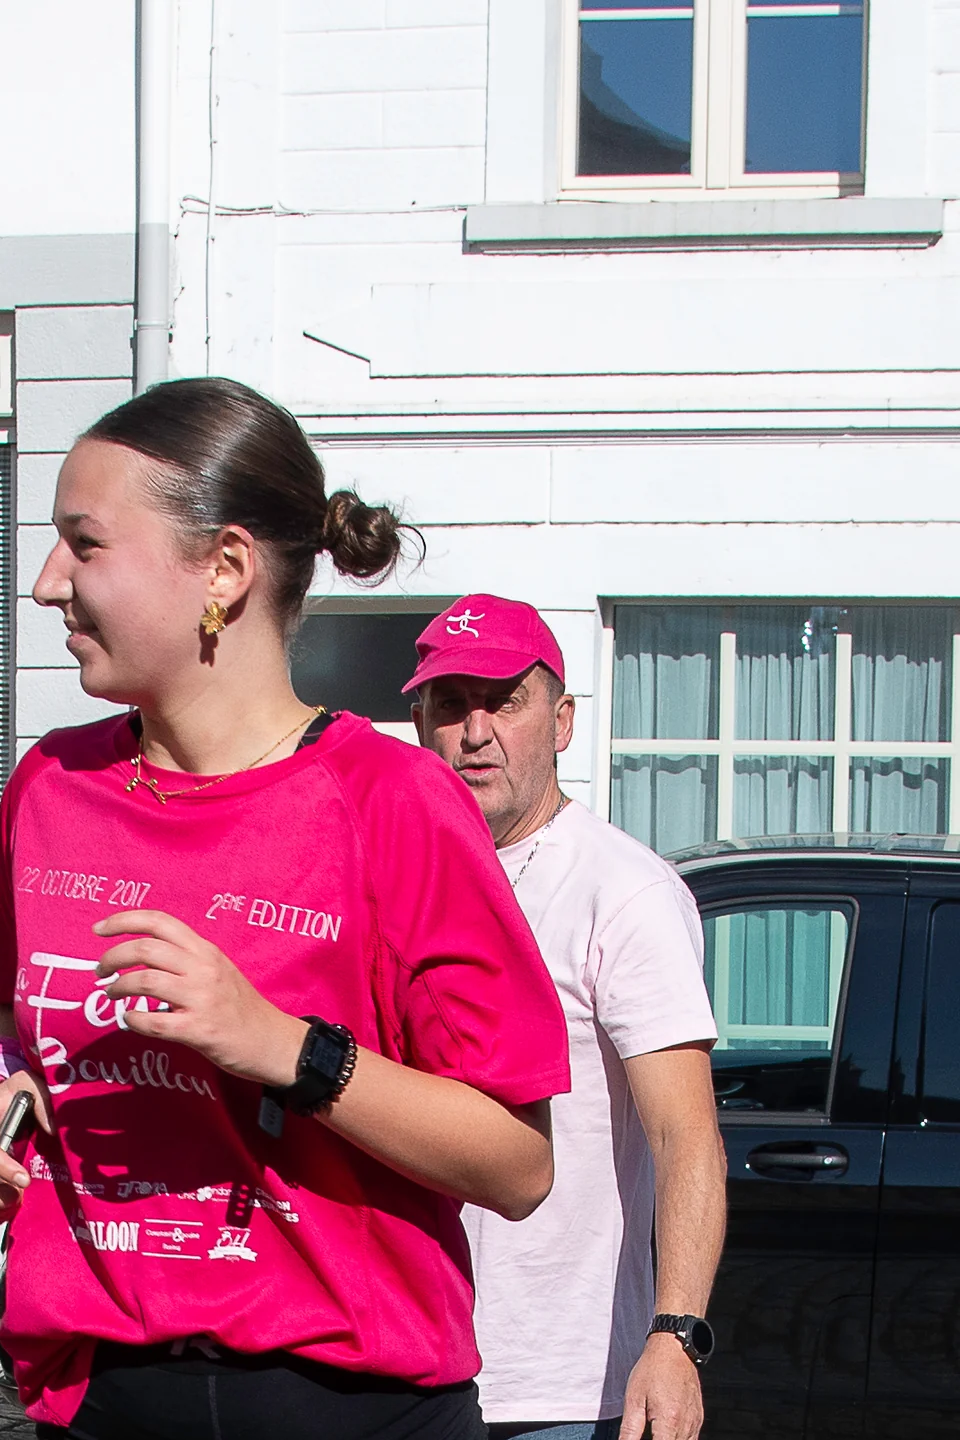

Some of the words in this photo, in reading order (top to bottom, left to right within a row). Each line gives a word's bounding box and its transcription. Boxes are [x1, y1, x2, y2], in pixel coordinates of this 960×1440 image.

[17, 867, 40, 893] 22
[40, 869, 108, 903] OCTOBRE
[108, 879, 152, 908] 2017
[248, 898, 342, 942] EDITION
[31, 1036, 217, 1101] Bouillon
